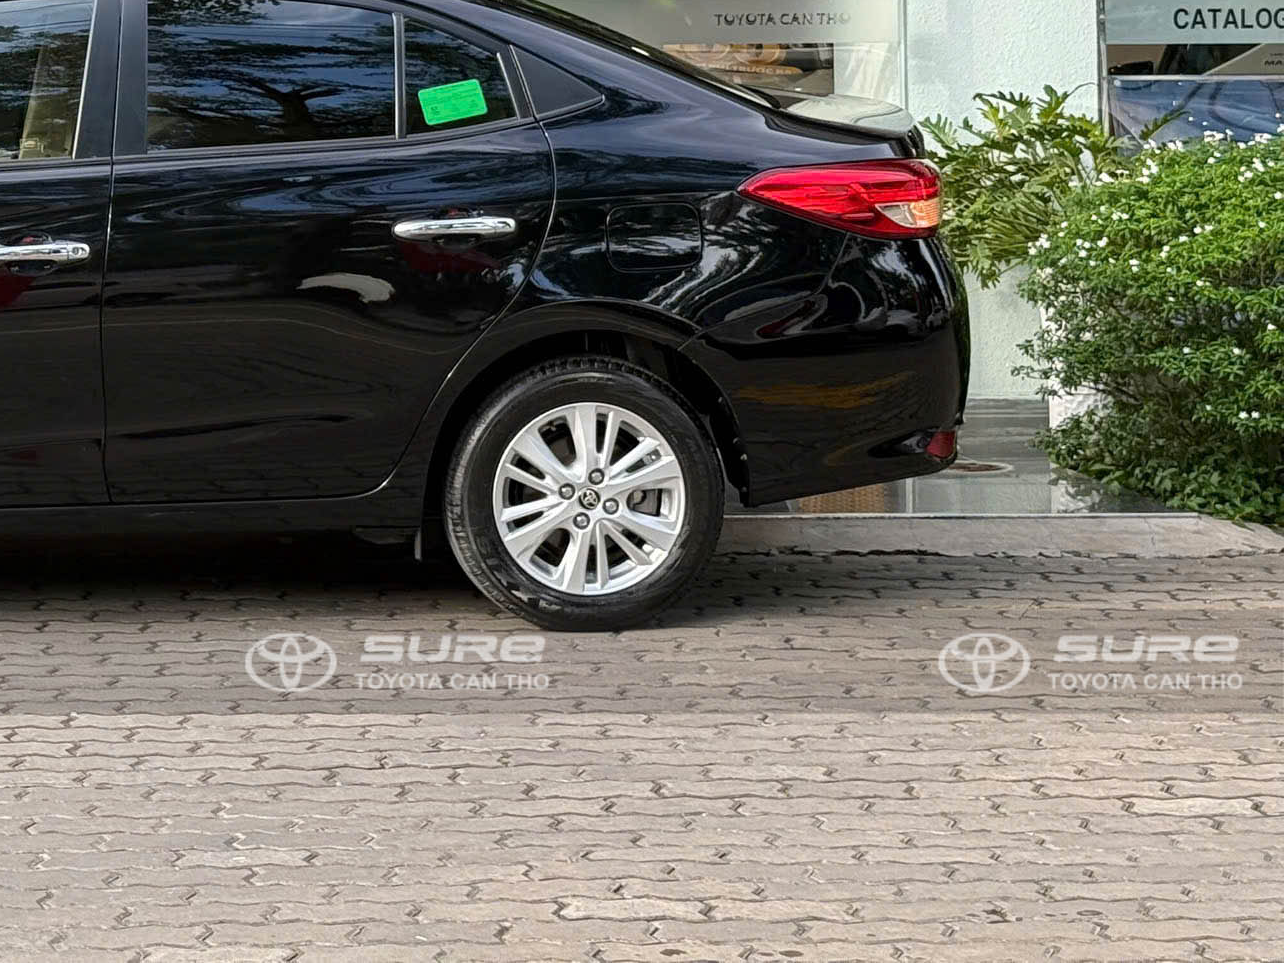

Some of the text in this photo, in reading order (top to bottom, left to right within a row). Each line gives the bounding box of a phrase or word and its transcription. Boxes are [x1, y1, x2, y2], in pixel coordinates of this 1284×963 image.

[714, 12, 851, 26] TOYOTA CAN THO
